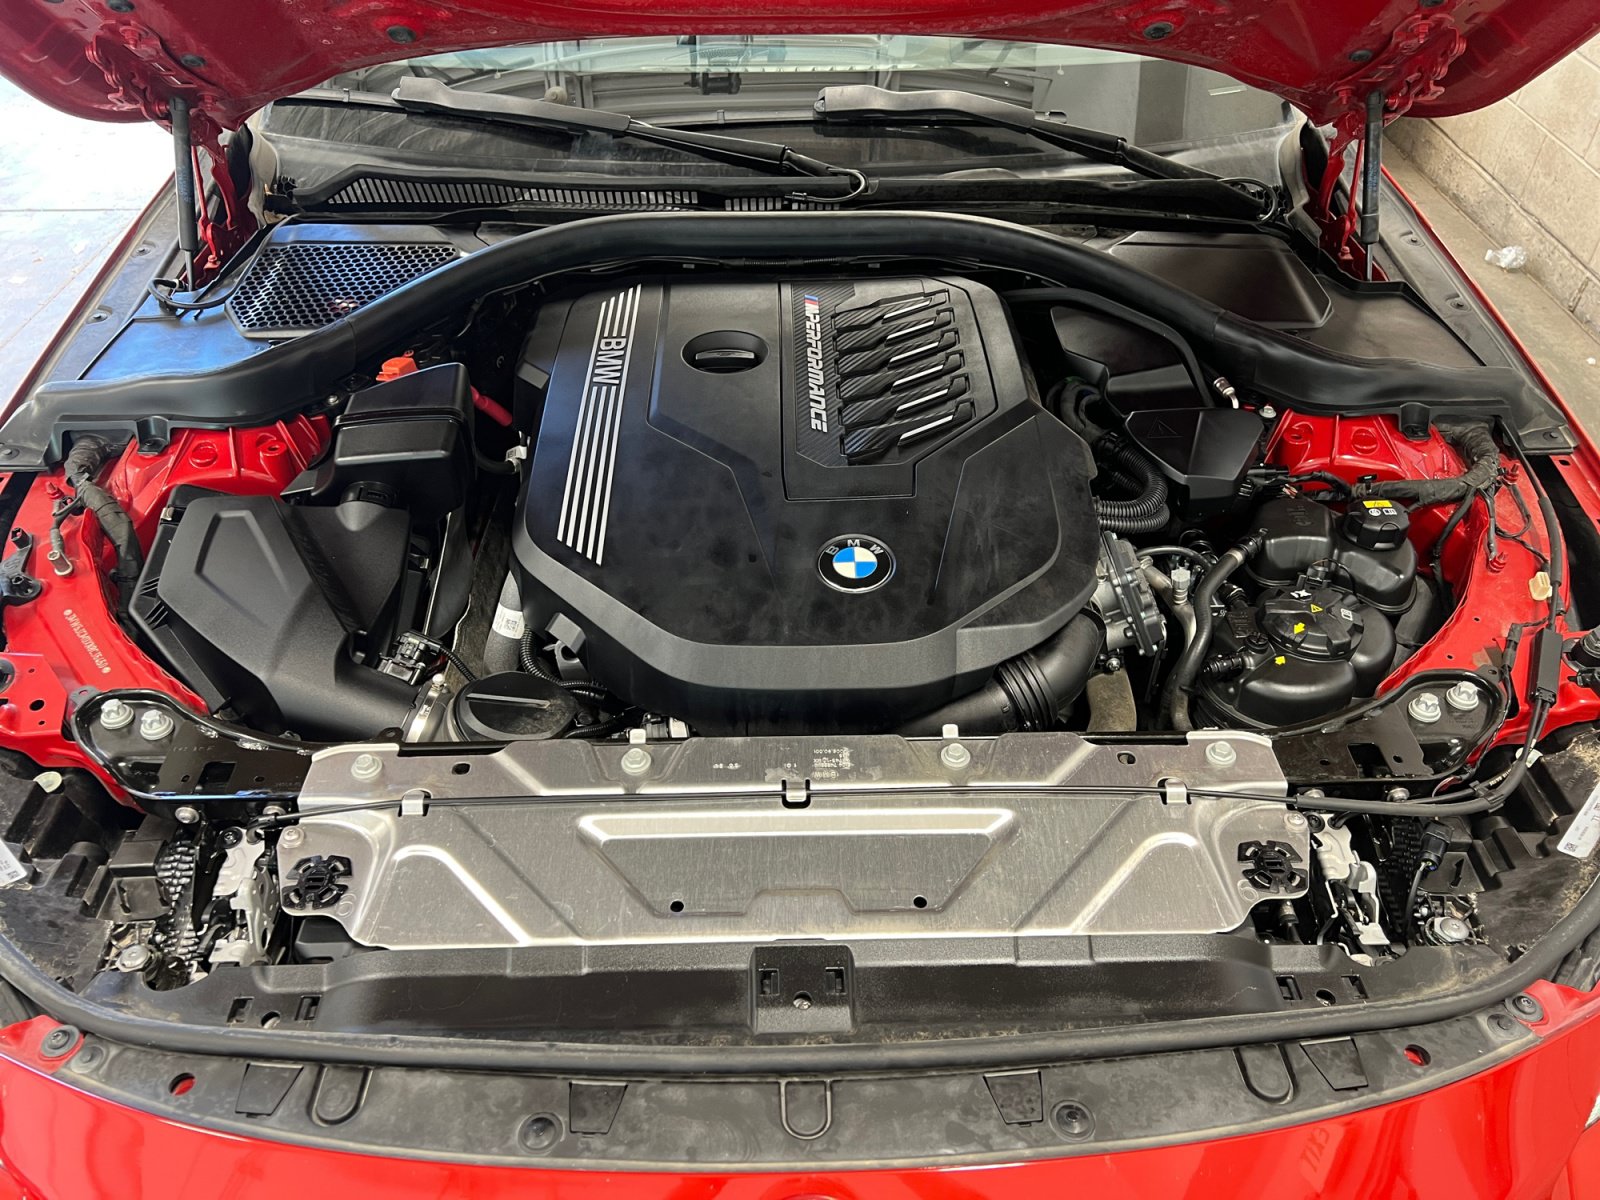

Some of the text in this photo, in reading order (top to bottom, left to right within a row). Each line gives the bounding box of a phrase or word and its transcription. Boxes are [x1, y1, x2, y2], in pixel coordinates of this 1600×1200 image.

[592, 338, 627, 385] BMW
[805, 312, 828, 433] PERFORMANCE
[825, 538, 885, 556] BMW
